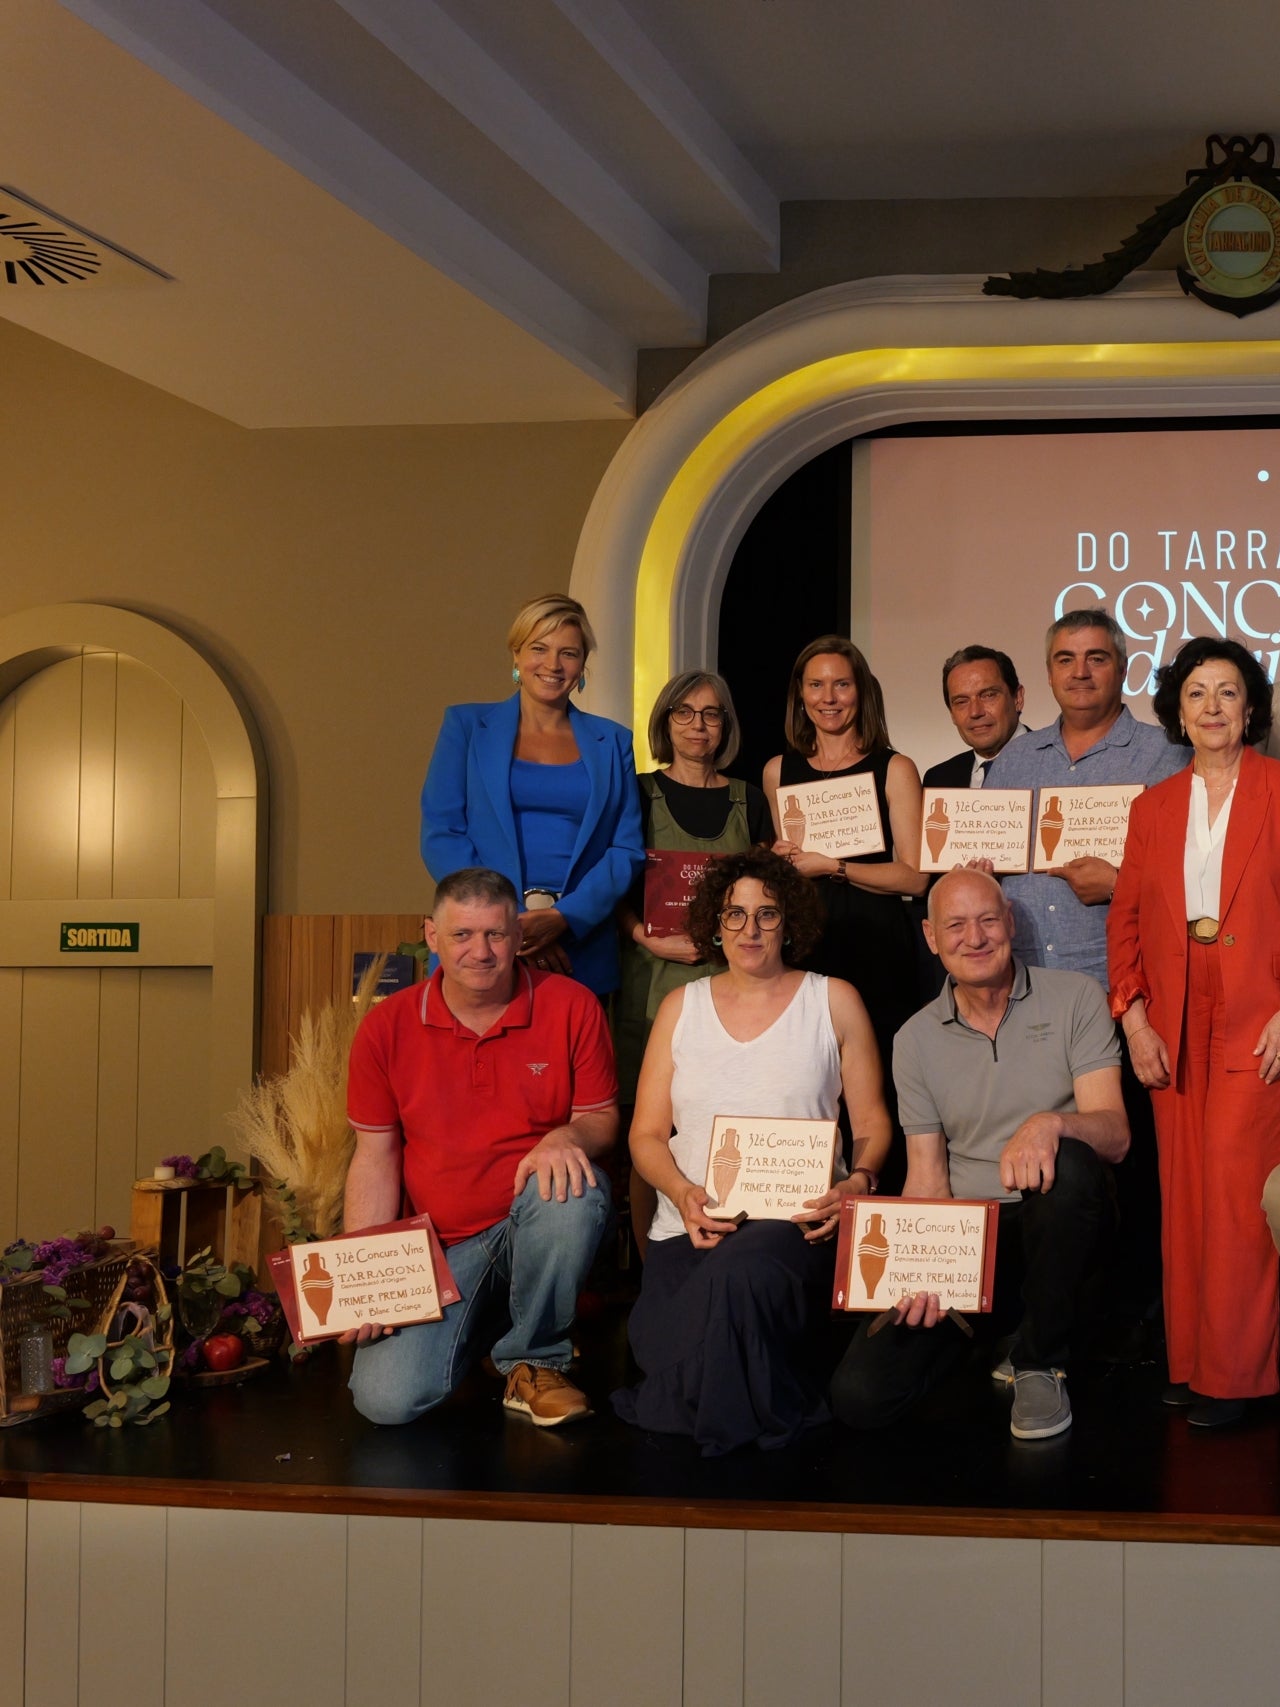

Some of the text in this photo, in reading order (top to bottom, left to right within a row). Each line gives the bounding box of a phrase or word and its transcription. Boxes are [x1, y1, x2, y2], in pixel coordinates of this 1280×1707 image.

[1222, 187, 1242, 202] DE
[1208, 232, 1271, 252] TARRAGONA
[1077, 531, 1129, 572] DO
[822, 791, 852, 803] Concurs
[855, 785, 871, 797] Vins
[971, 800, 1005, 813] Concurs
[1009, 801, 1026, 813] Vins
[1085, 797, 1118, 809] Concurs
[808, 805, 872, 820] TARRAGONA
[954, 820, 1023, 828] TARRAGONA
[1068, 816, 1128, 825] TARRAGON
[810, 823, 877, 841] PRIMER PREMI 2026
[1007, 841, 1025, 849] 2026
[1064, 838, 1116, 847] PRIMER PREMI
[68, 928, 131, 946] SORTIDA
[767, 1133, 805, 1148] Concurs
[809, 1135, 828, 1149] Vins
[746, 1157, 824, 1168] TARRAGONA
[740, 1182, 824, 1194] PRIMER PREMI 2026
[765, 1198, 771, 1207] Vi
[915, 1218, 955, 1234] Concurs
[960, 1219, 980, 1236] Vins
[356, 1248, 399, 1263] Concurs
[401, 1242, 424, 1256] Vins
[894, 1244, 976, 1256] TARRAGONA
[338, 1264, 426, 1283] TARRAGONA
[889, 1272, 978, 1283] PRIMER PREMI 2026
[339, 1285, 432, 1307] PRIMER PREMI 2026
[888, 1288, 896, 1296] Vi
[354, 1310, 363, 1318] Vi
[369, 1307, 389, 1317] Blanc
